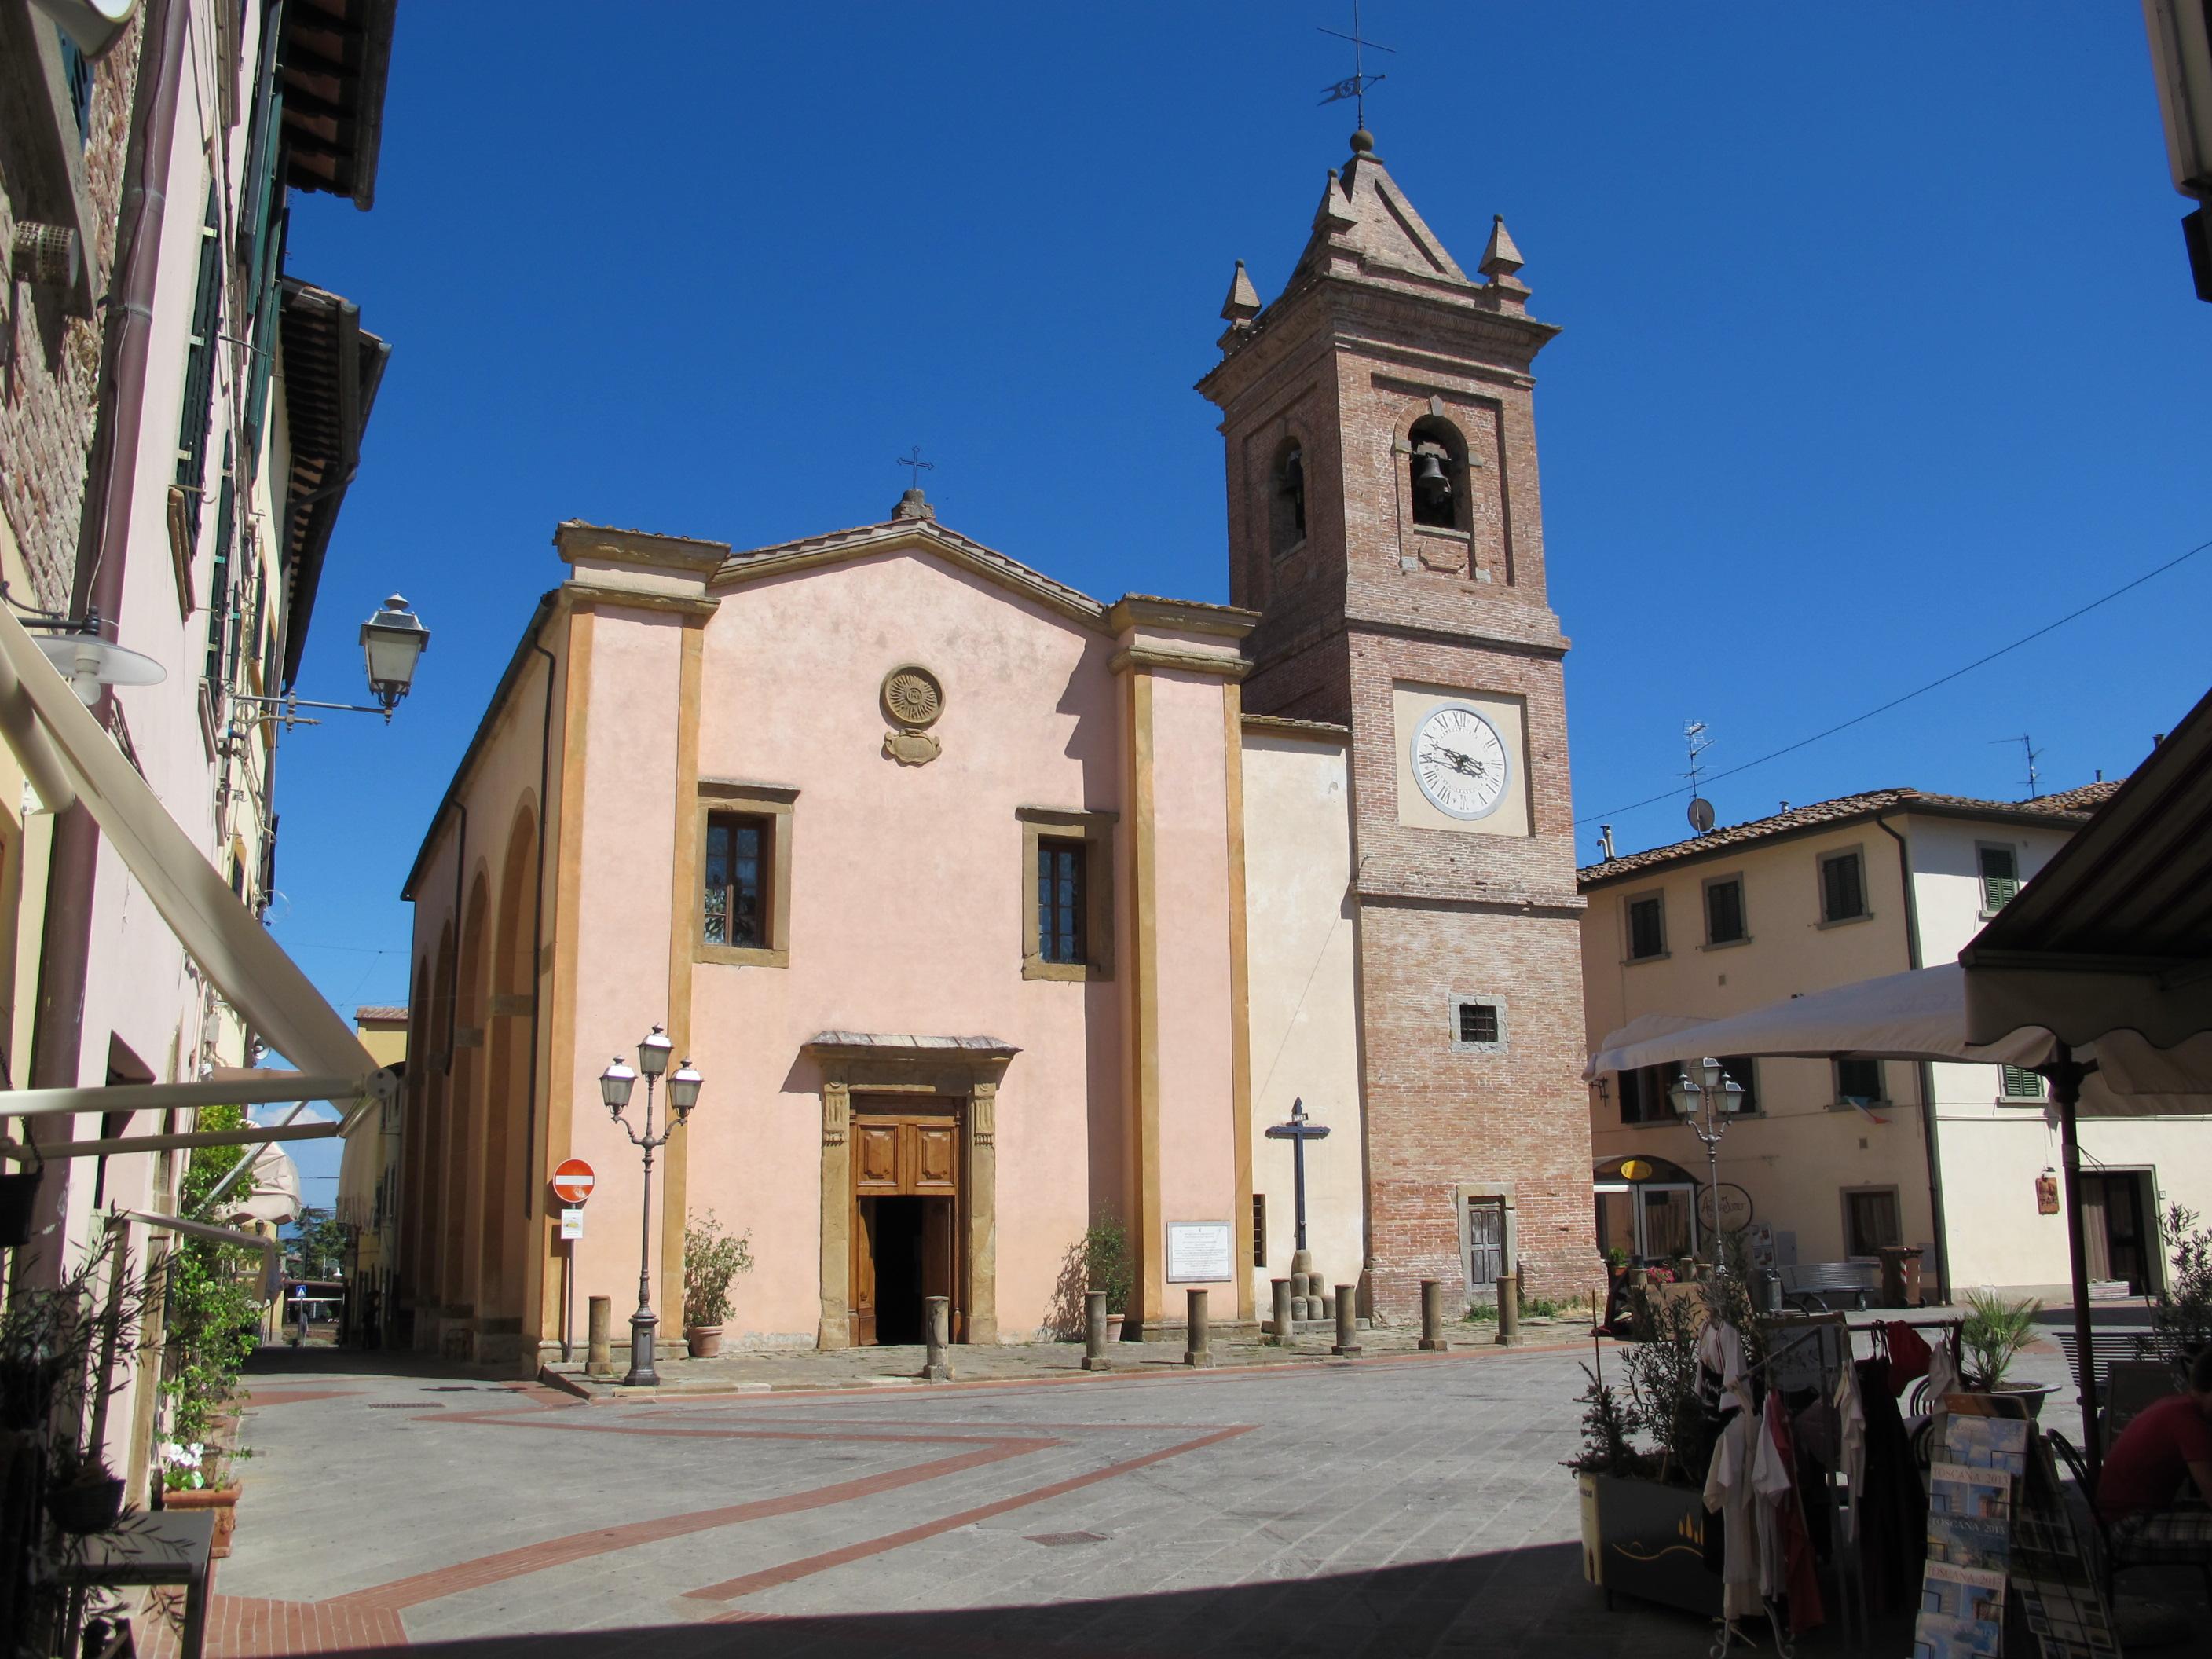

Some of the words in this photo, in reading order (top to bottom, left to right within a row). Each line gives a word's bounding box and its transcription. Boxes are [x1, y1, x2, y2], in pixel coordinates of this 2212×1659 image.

[1434, 714, 1448, 729] XI
[1452, 711, 1467, 727] XII
[1486, 738, 1497, 748] II
[1932, 1467, 1980, 1482] TOSCANA
[1985, 1474, 2009, 1485] 2013
[1932, 1517, 1979, 1532] TOSCANA
[1984, 1524, 2005, 1534] 2013
[1928, 1565, 1975, 1584] TOSCANA
[1980, 1574, 2002, 1588] 2013
